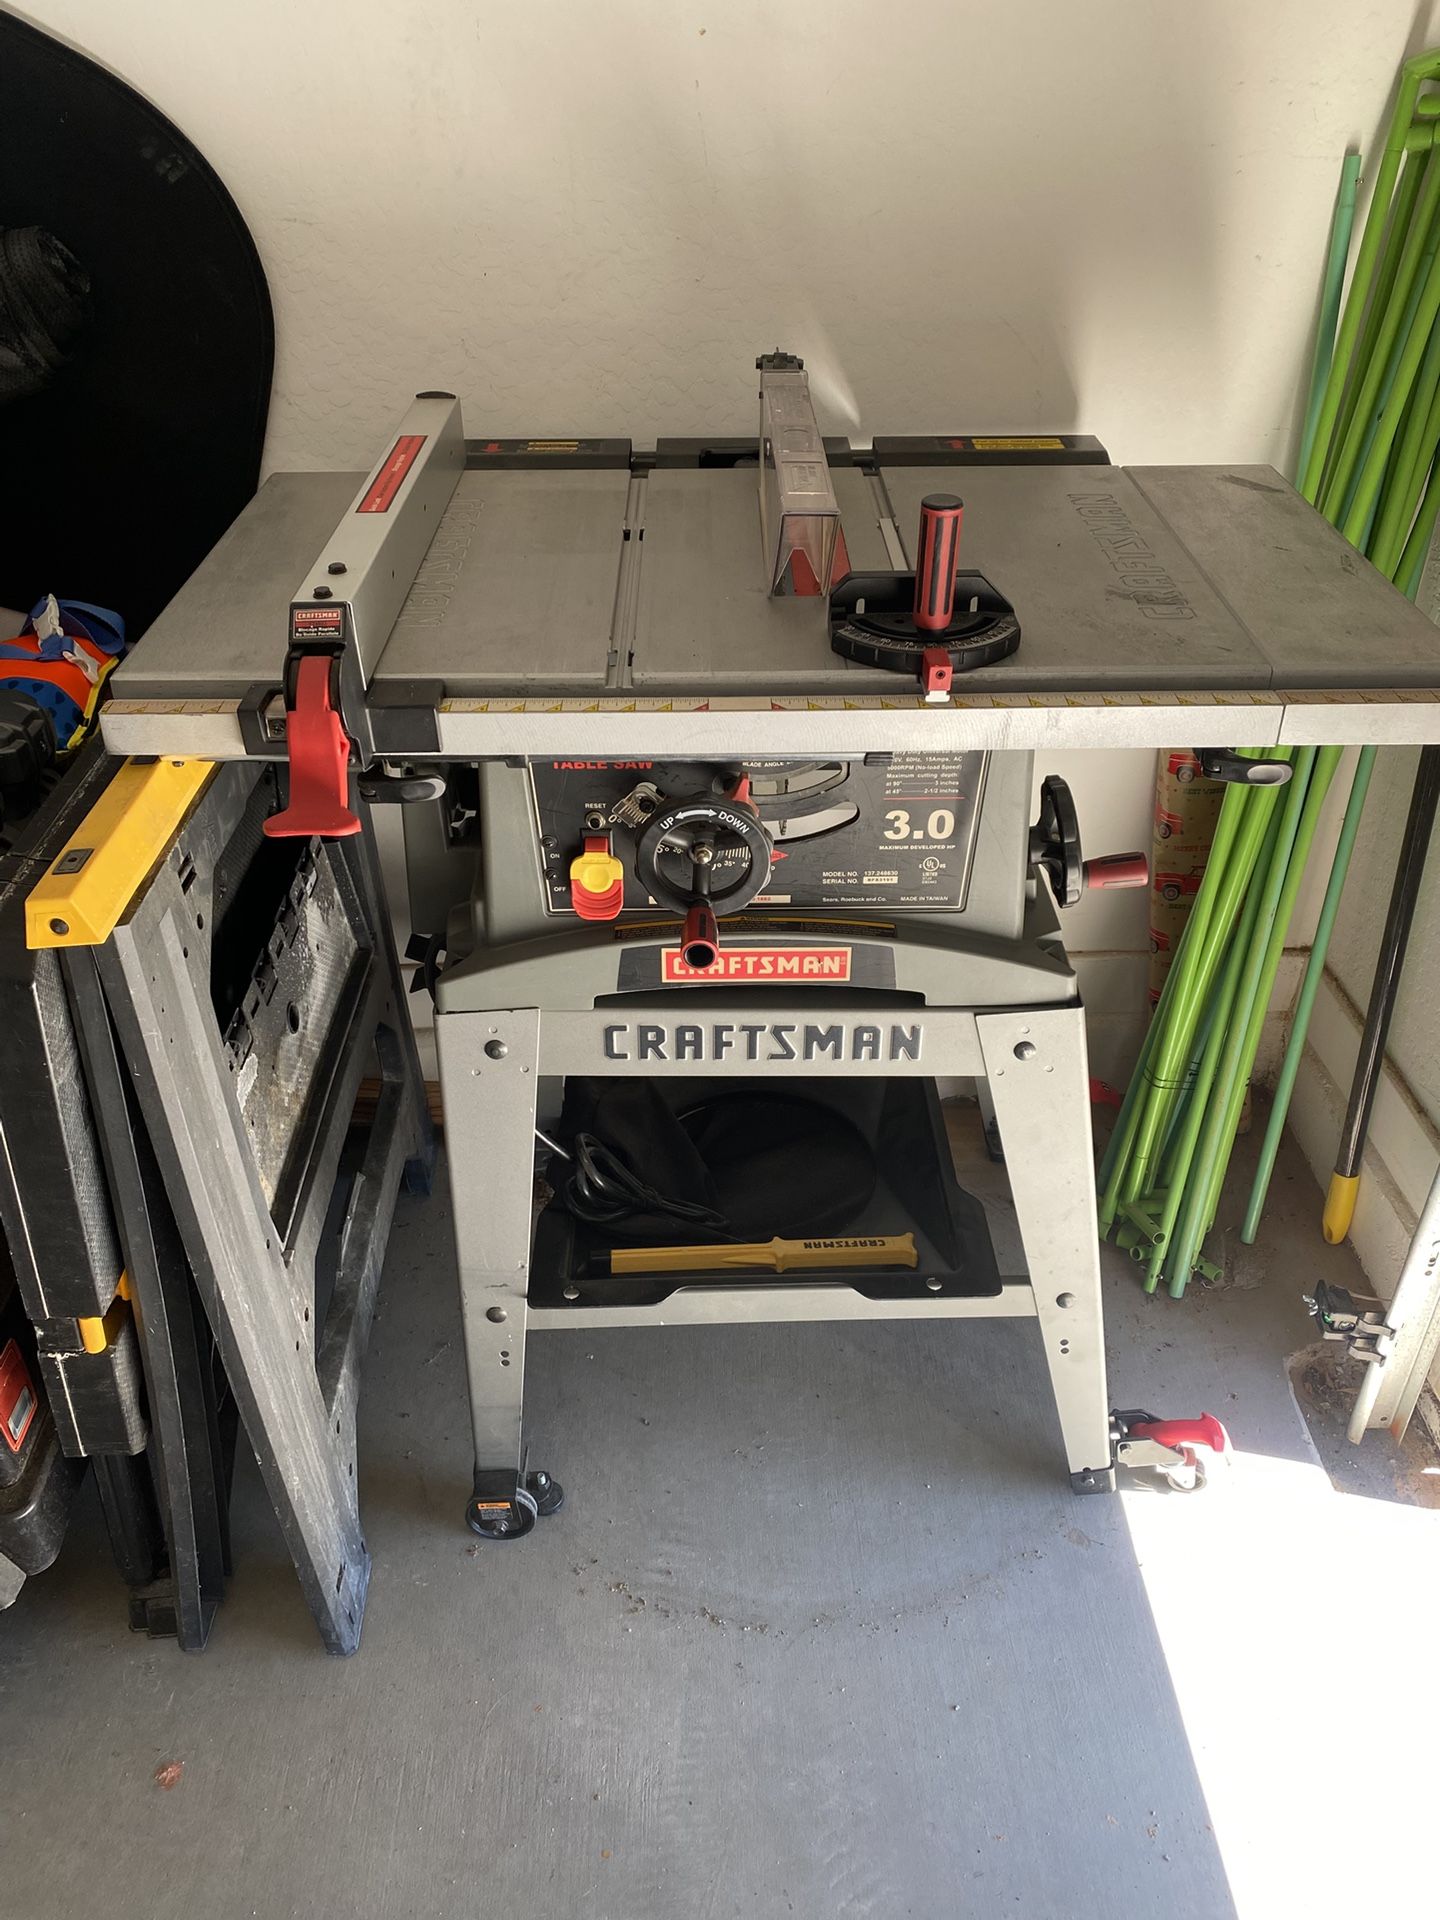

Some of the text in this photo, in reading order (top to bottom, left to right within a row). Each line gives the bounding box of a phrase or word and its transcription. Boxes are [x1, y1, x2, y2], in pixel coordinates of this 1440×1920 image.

[660, 811, 750, 834] UP DOWN
[883, 809, 955, 840] 3.0
[673, 956, 840, 975] CAFTSMAN
[604, 1024, 923, 1060] CRAFTSMAN
[803, 1239, 886, 1249] CRAFTSMAN
